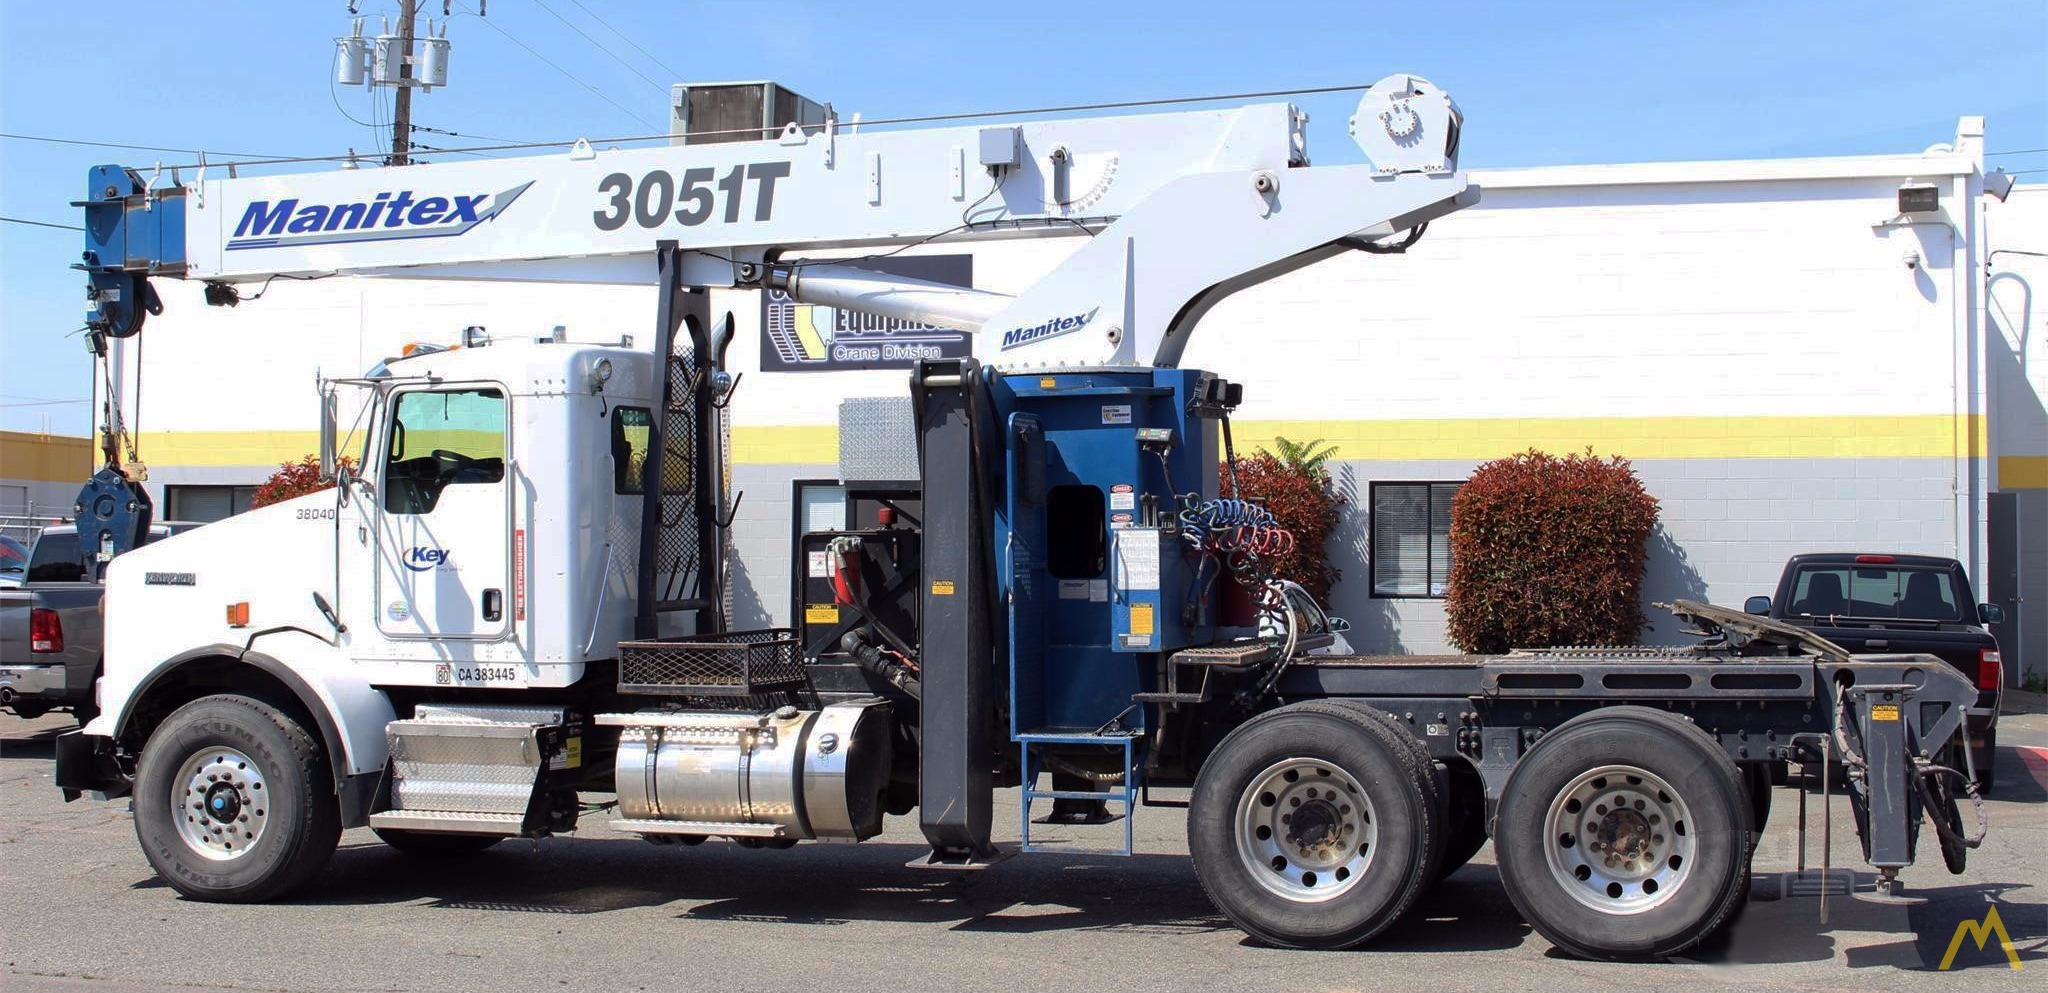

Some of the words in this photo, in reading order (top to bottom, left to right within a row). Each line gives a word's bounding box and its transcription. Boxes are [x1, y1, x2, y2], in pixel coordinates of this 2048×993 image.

[593, 161, 791, 231] 3051T
[233, 190, 490, 237] Manitex
[1003, 314, 1086, 346] Manitex
[834, 346, 880, 360] Crane
[883, 344, 942, 360] Division
[296, 508, 336, 520] 38040
[412, 546, 450, 566] Key
[437, 669, 449, 683] 80
[458, 668, 473, 681] CA
[474, 667, 516, 681] 383445
[192, 722, 283, 784] KUMHO
